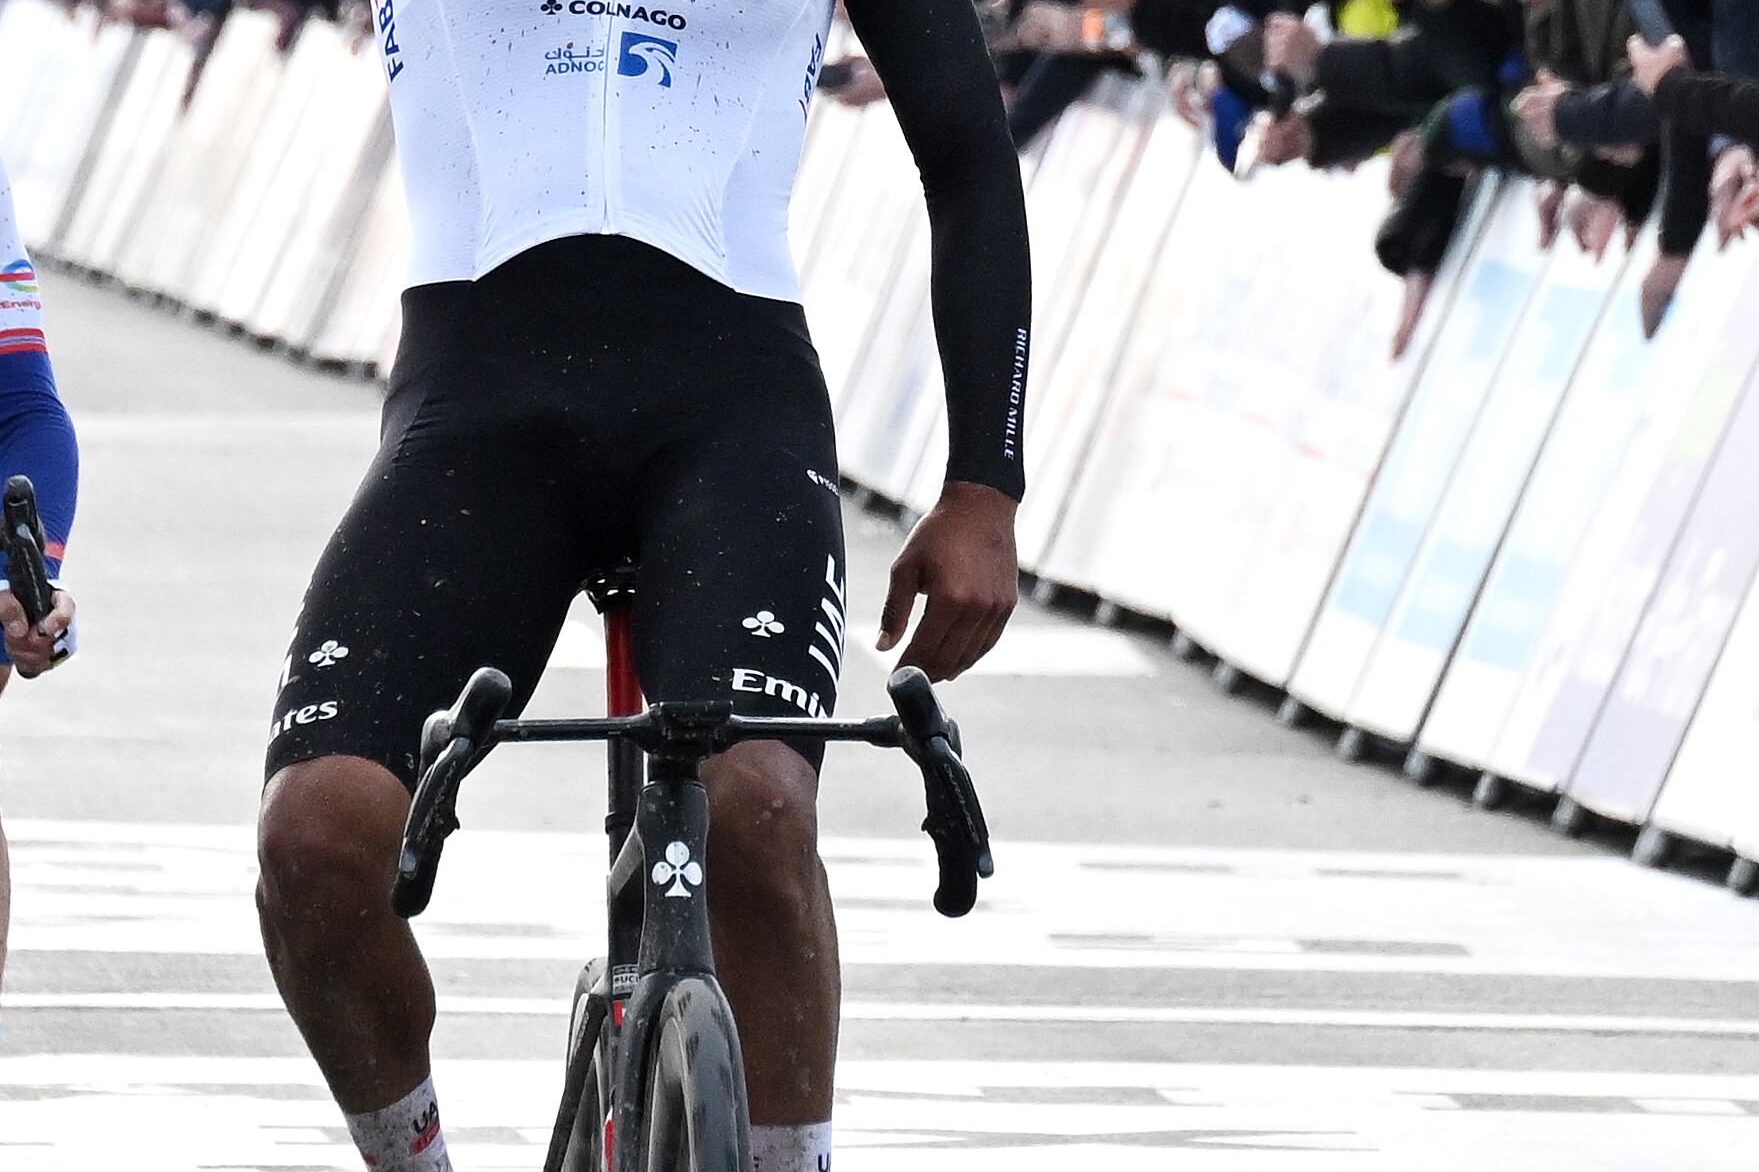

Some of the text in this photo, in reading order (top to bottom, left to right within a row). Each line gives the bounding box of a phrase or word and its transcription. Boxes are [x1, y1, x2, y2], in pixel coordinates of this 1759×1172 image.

[567, 0, 688, 31] COLNAGO
[1003, 327, 1028, 461] RICHARD MILLE
